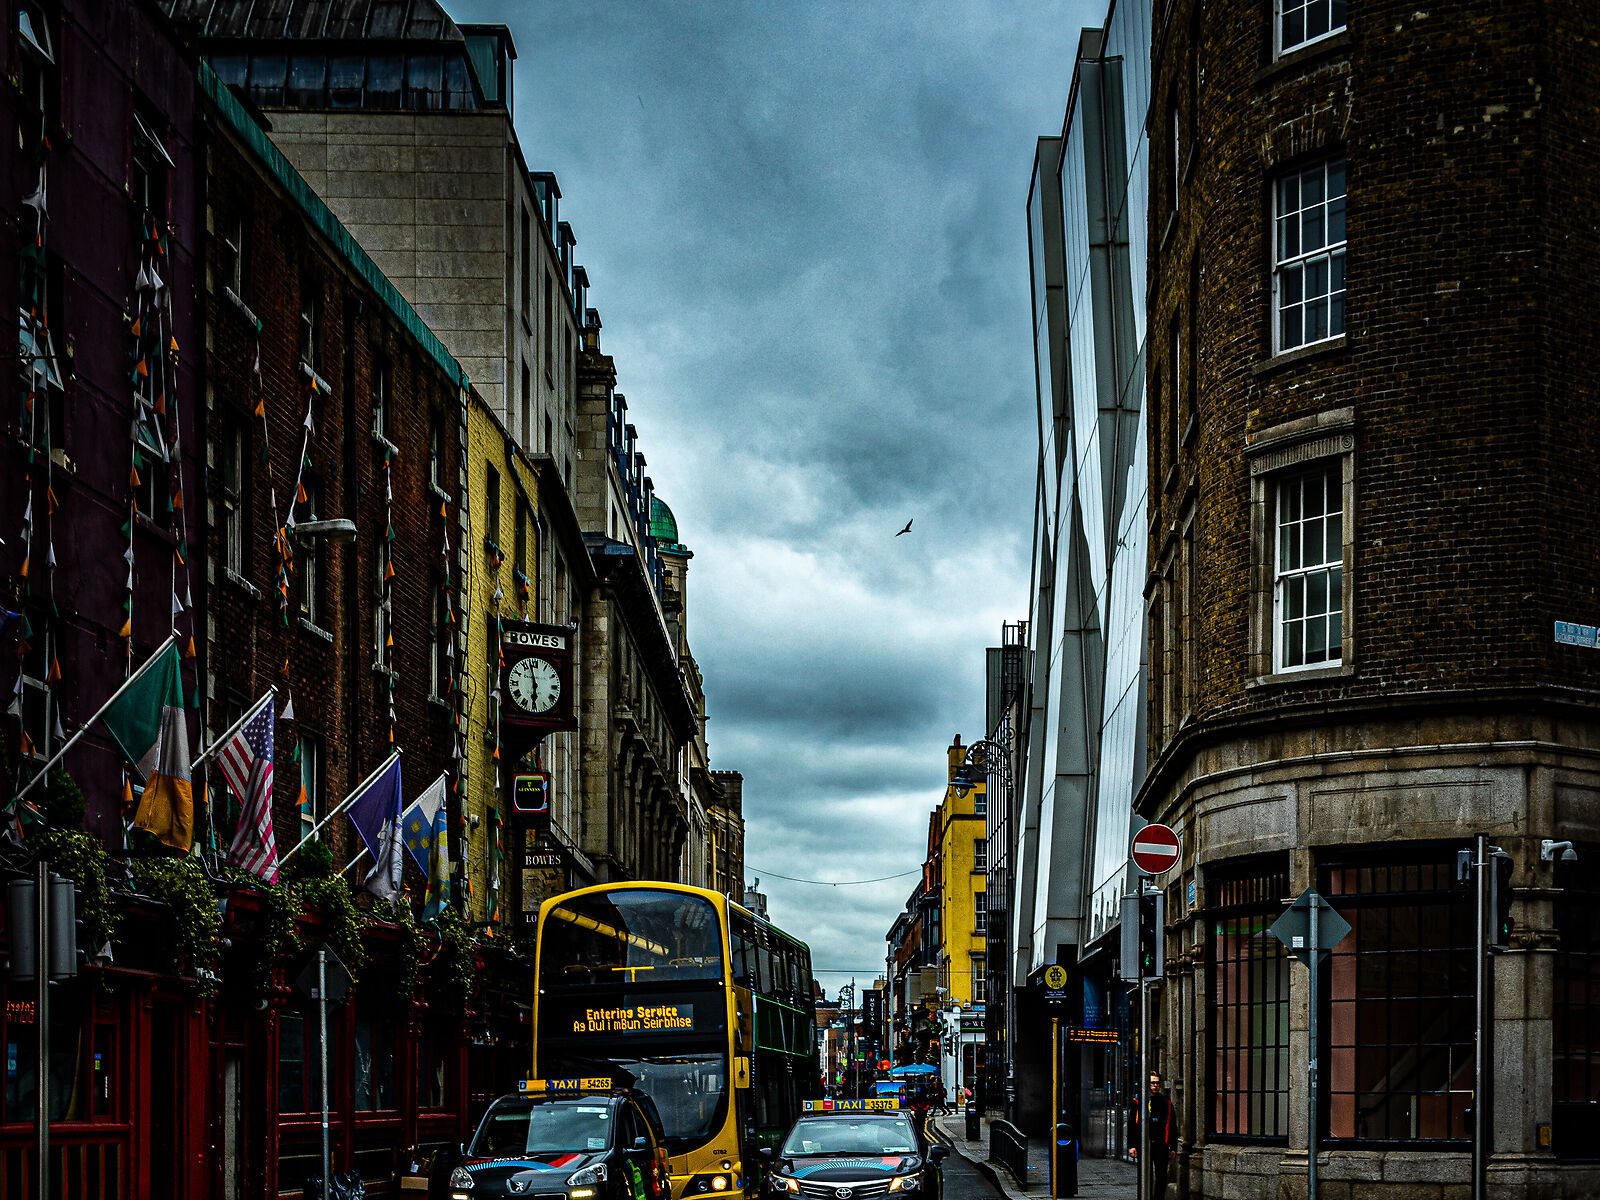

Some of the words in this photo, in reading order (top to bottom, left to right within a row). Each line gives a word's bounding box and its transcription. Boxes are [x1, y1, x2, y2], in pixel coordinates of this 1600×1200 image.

[510, 632, 559, 647] BOWES
[525, 855, 561, 866] BOWES
[586, 1008, 634, 1020] Entering
[637, 1005, 678, 1019] Service
[573, 1021, 586, 1032] Ag
[588, 1020, 605, 1031] Dul
[613, 1018, 641, 1031] mBun
[520, 1081, 527, 1090] D
[552, 1080, 578, 1089] TAXI
[587, 1079, 610, 1088] 54265
[805, 1101, 812, 1110] D
[836, 1100, 862, 1109] TAXI
[870, 1100, 893, 1109] 35375
